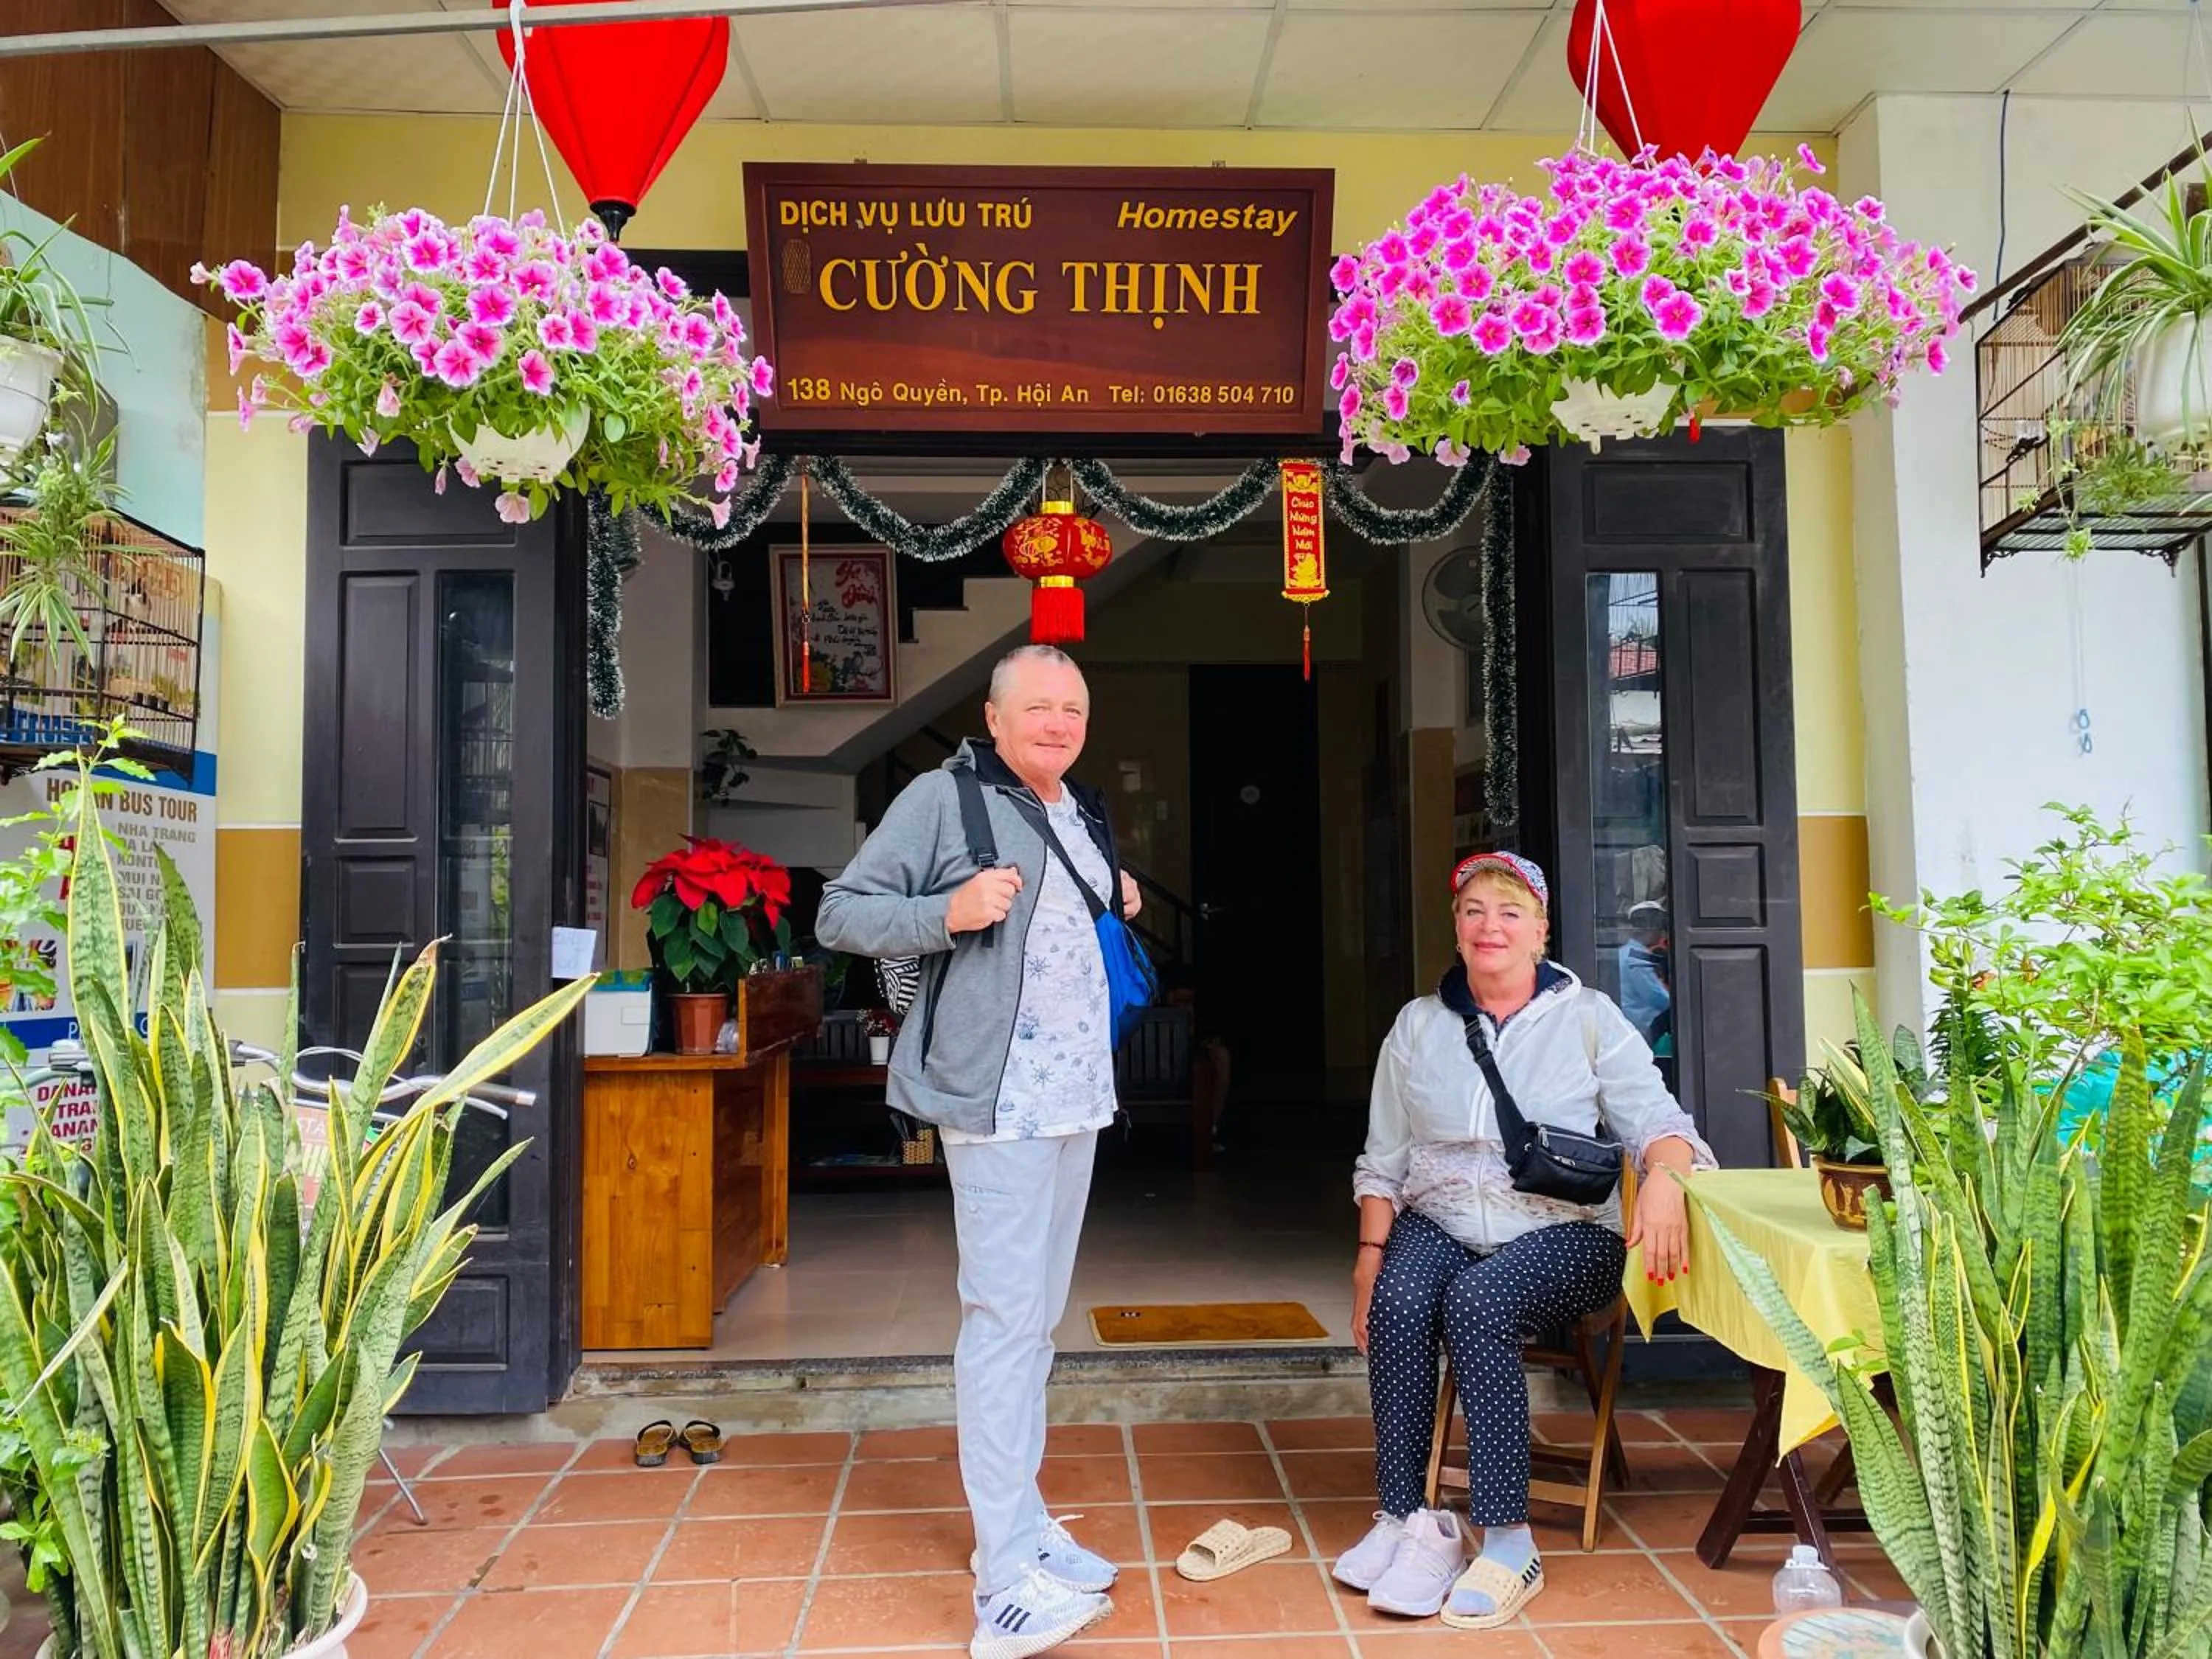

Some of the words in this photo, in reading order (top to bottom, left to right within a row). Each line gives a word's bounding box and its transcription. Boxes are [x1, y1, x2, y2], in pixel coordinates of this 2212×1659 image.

[780, 200, 847, 234] DỊCH
[859, 201, 899, 234] VỤ
[911, 198, 965, 227] LƯU
[977, 197, 1032, 229] TRÚ
[1117, 201, 1298, 237] Homestay
[819, 243, 1037, 314] CƯỜNG
[1062, 262, 1262, 330] THỊNH
[787, 378, 831, 400] 138
[840, 382, 883, 406] Ngô
[893, 378, 968, 406] Quyền,
[975, 384, 1008, 405] Tp.
[1018, 383, 1051, 406] Hội
[1061, 385, 1089, 403] An
[1109, 385, 1145, 403] Tel:
[1153, 386, 1212, 403] 01638
[1217, 386, 1254, 403] 504
[1261, 386, 1295, 404] 710
[119, 790, 153, 815] BUS
[159, 796, 198, 823] TOUR
[118, 822, 147, 837] NHA
[153, 827, 195, 843] TRANG
